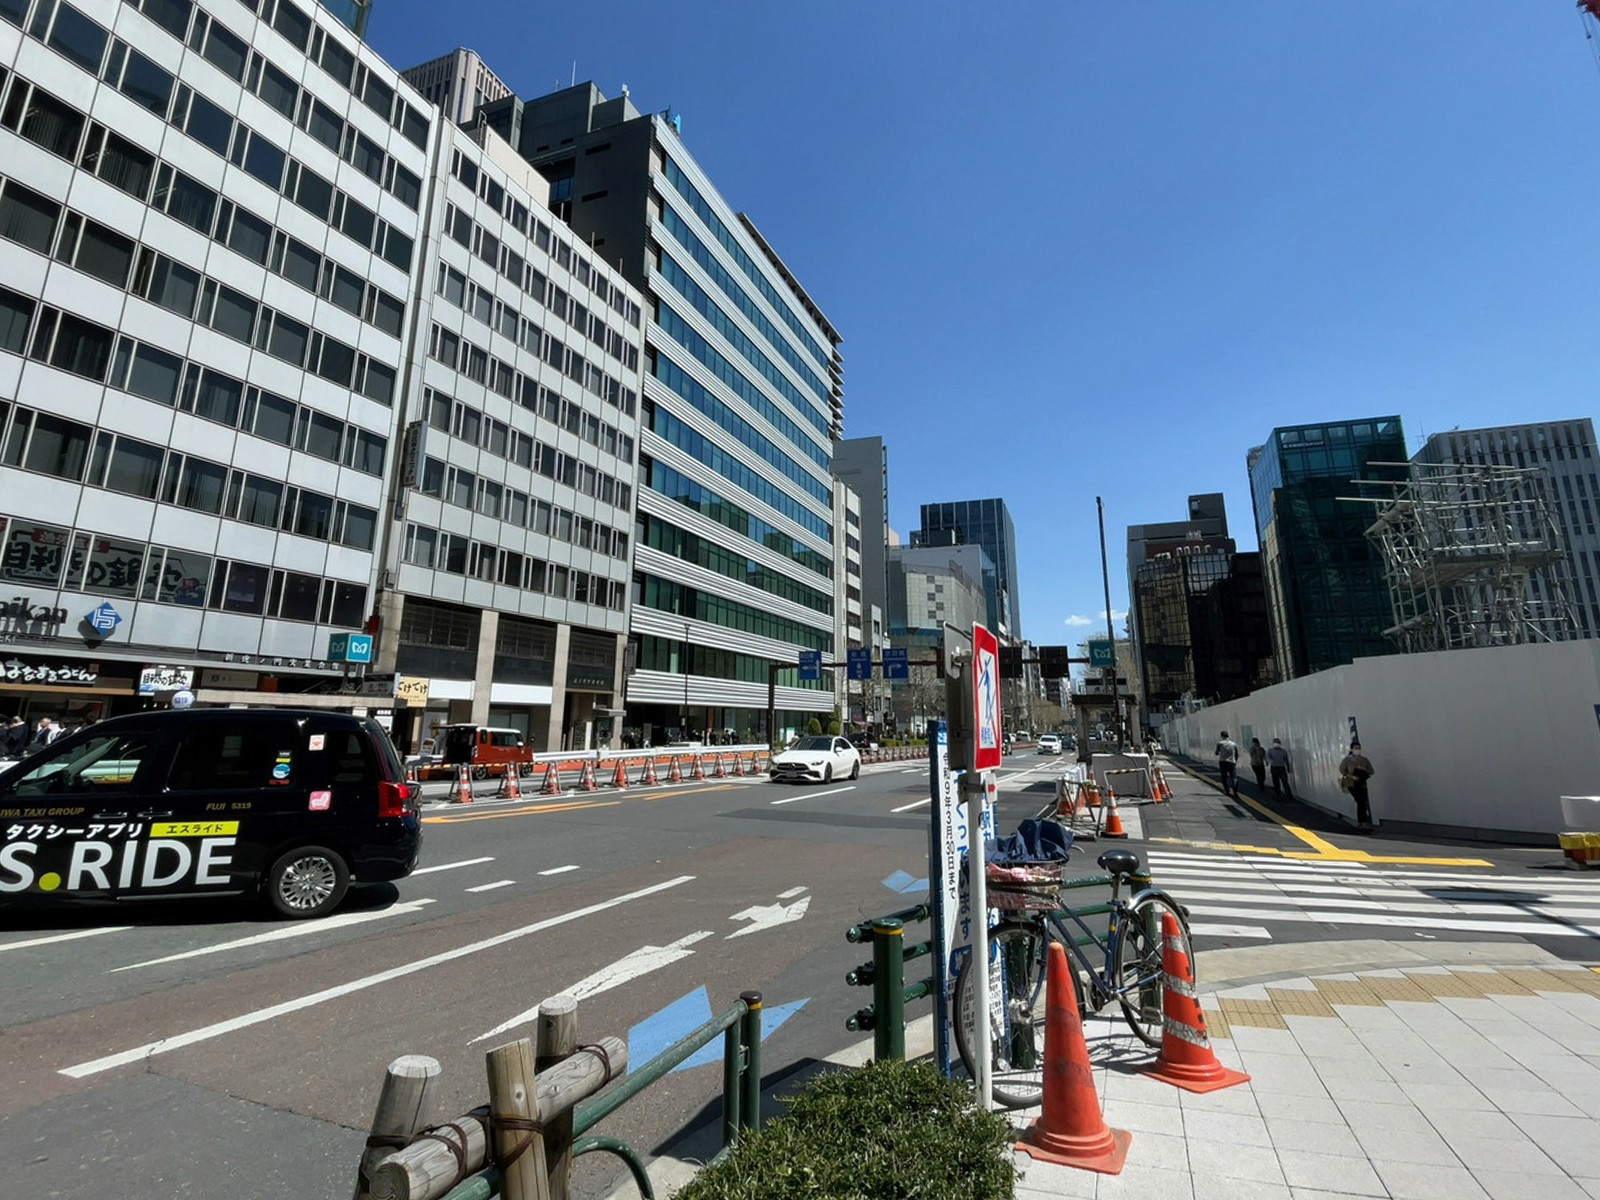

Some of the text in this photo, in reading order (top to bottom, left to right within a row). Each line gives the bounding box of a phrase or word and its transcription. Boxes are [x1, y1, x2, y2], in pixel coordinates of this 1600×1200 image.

[23, 808, 46, 816] TAXI
[48, 807, 85, 815] GROUP
[206, 803, 226, 811] FUJI
[6, 823, 143, 840] タクシーアプリ
[166, 824, 223, 834] エスライド
[0, 837, 237, 893] S.RIDE
